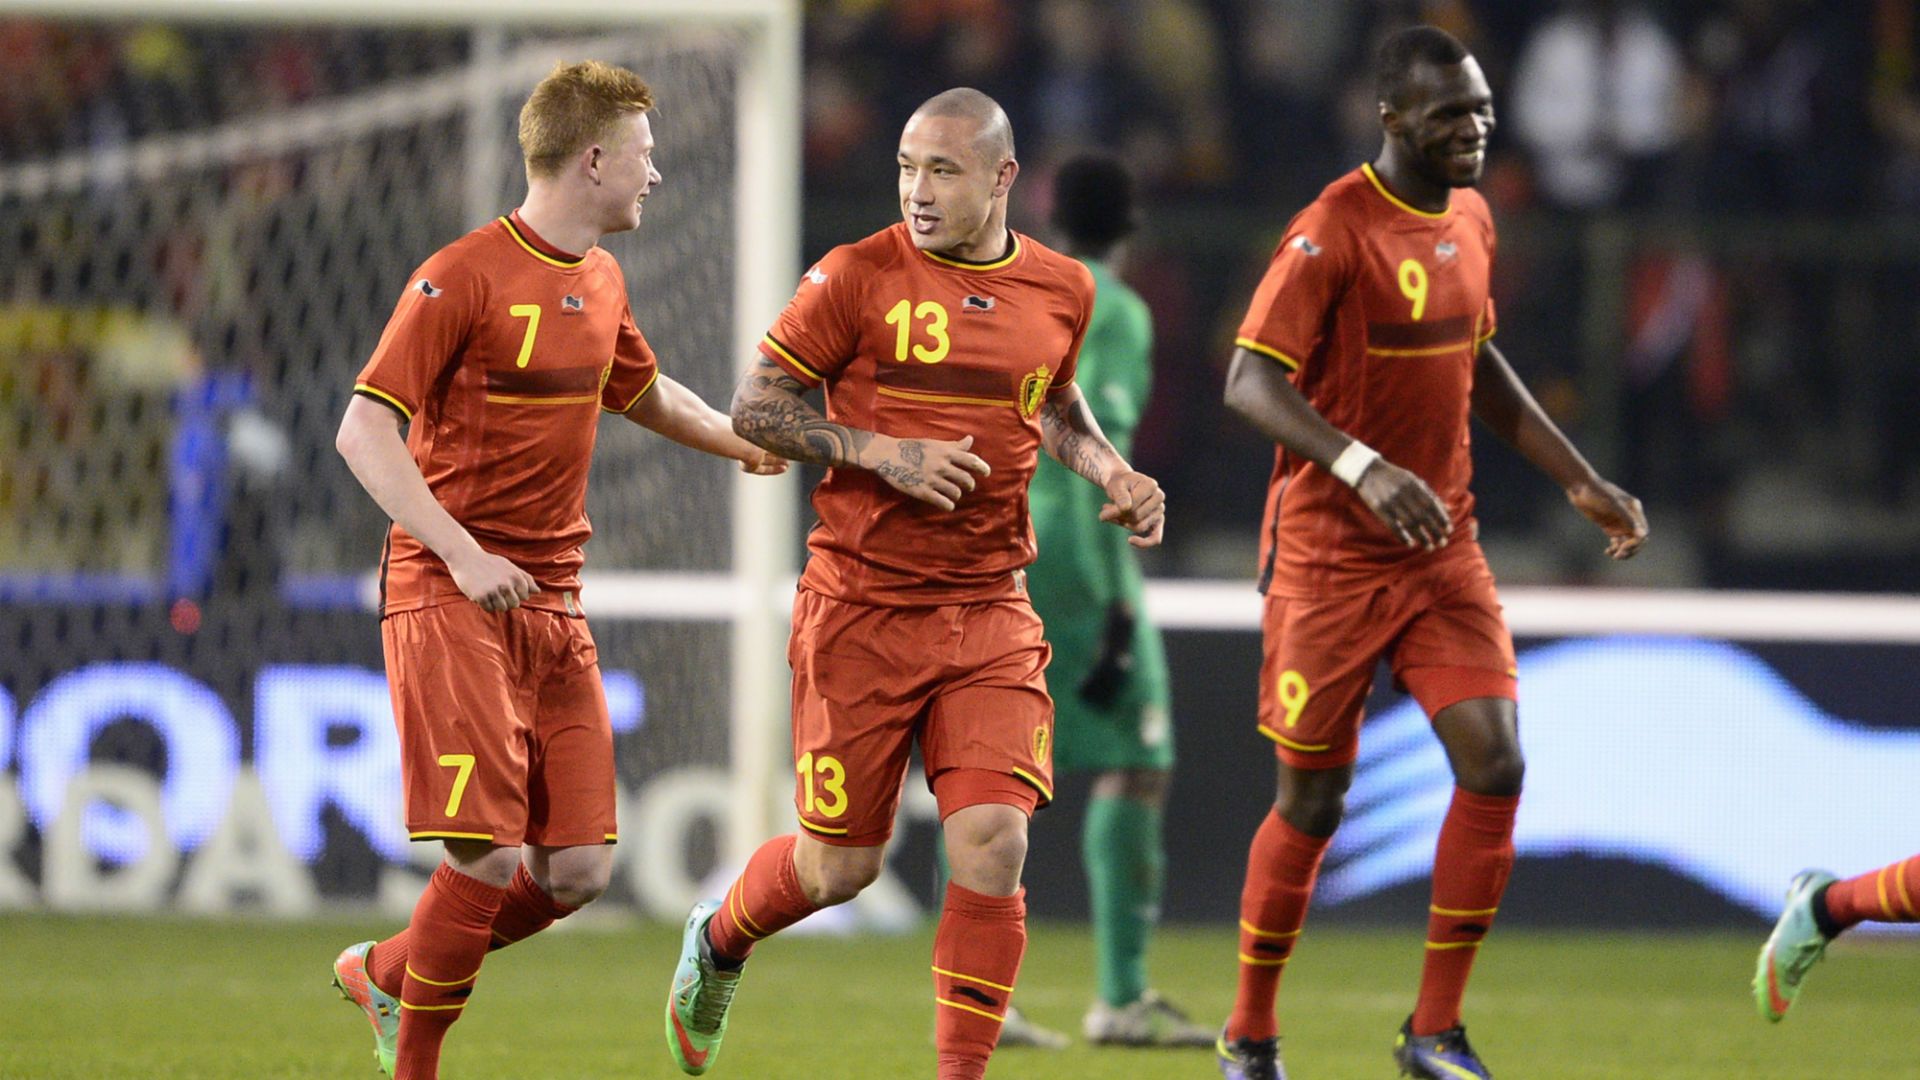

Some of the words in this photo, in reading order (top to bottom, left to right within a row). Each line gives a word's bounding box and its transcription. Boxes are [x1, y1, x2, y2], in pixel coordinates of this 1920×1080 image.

[1398, 258, 1428, 320] 9
[509, 304, 541, 368] 7
[885, 299, 950, 363] 13
[1278, 670, 1309, 727] 9
[438, 754, 475, 817] 7
[796, 751, 848, 817] 13
